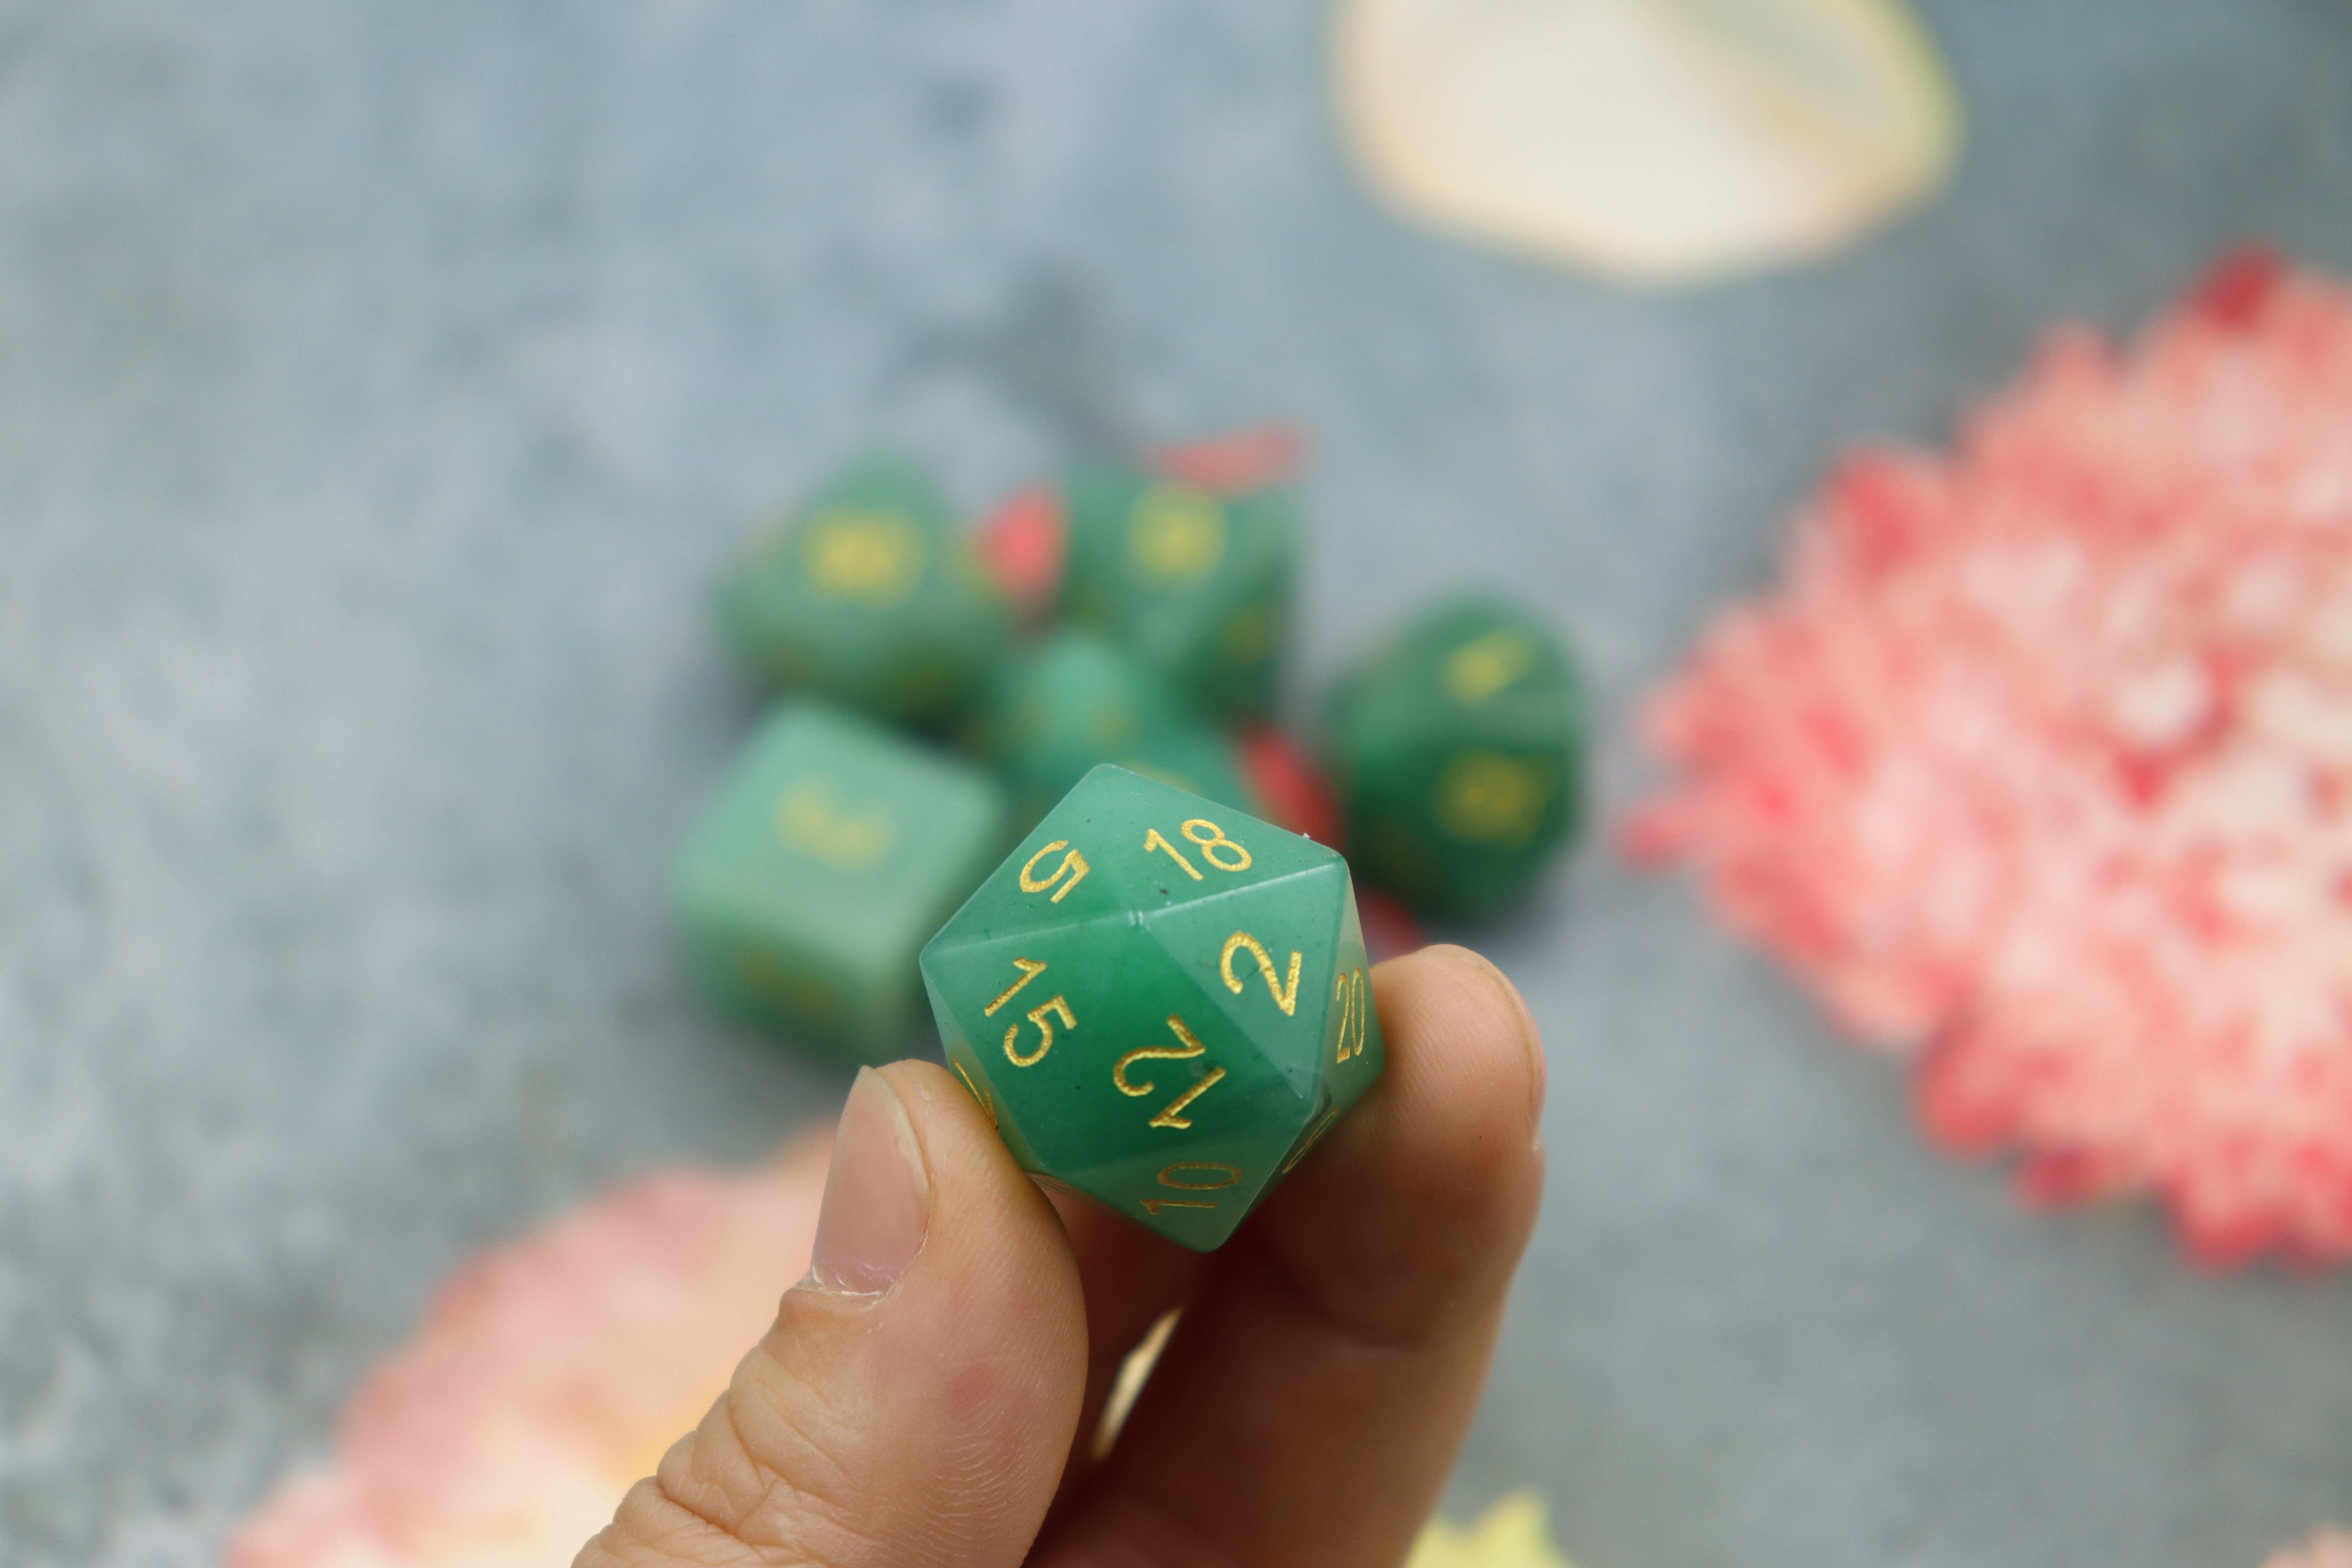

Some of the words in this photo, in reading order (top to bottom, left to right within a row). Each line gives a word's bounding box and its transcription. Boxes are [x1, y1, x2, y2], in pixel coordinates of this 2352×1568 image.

[1020, 840, 1091, 904] 5
[1143, 818, 1252, 881] 18
[984, 956, 1078, 1067] 15
[1220, 930, 1302, 1016] 2
[1336, 966, 1365, 1063] 20
[1113, 1013, 1227, 1130] 12
[1139, 1161, 1243, 1216] 10
